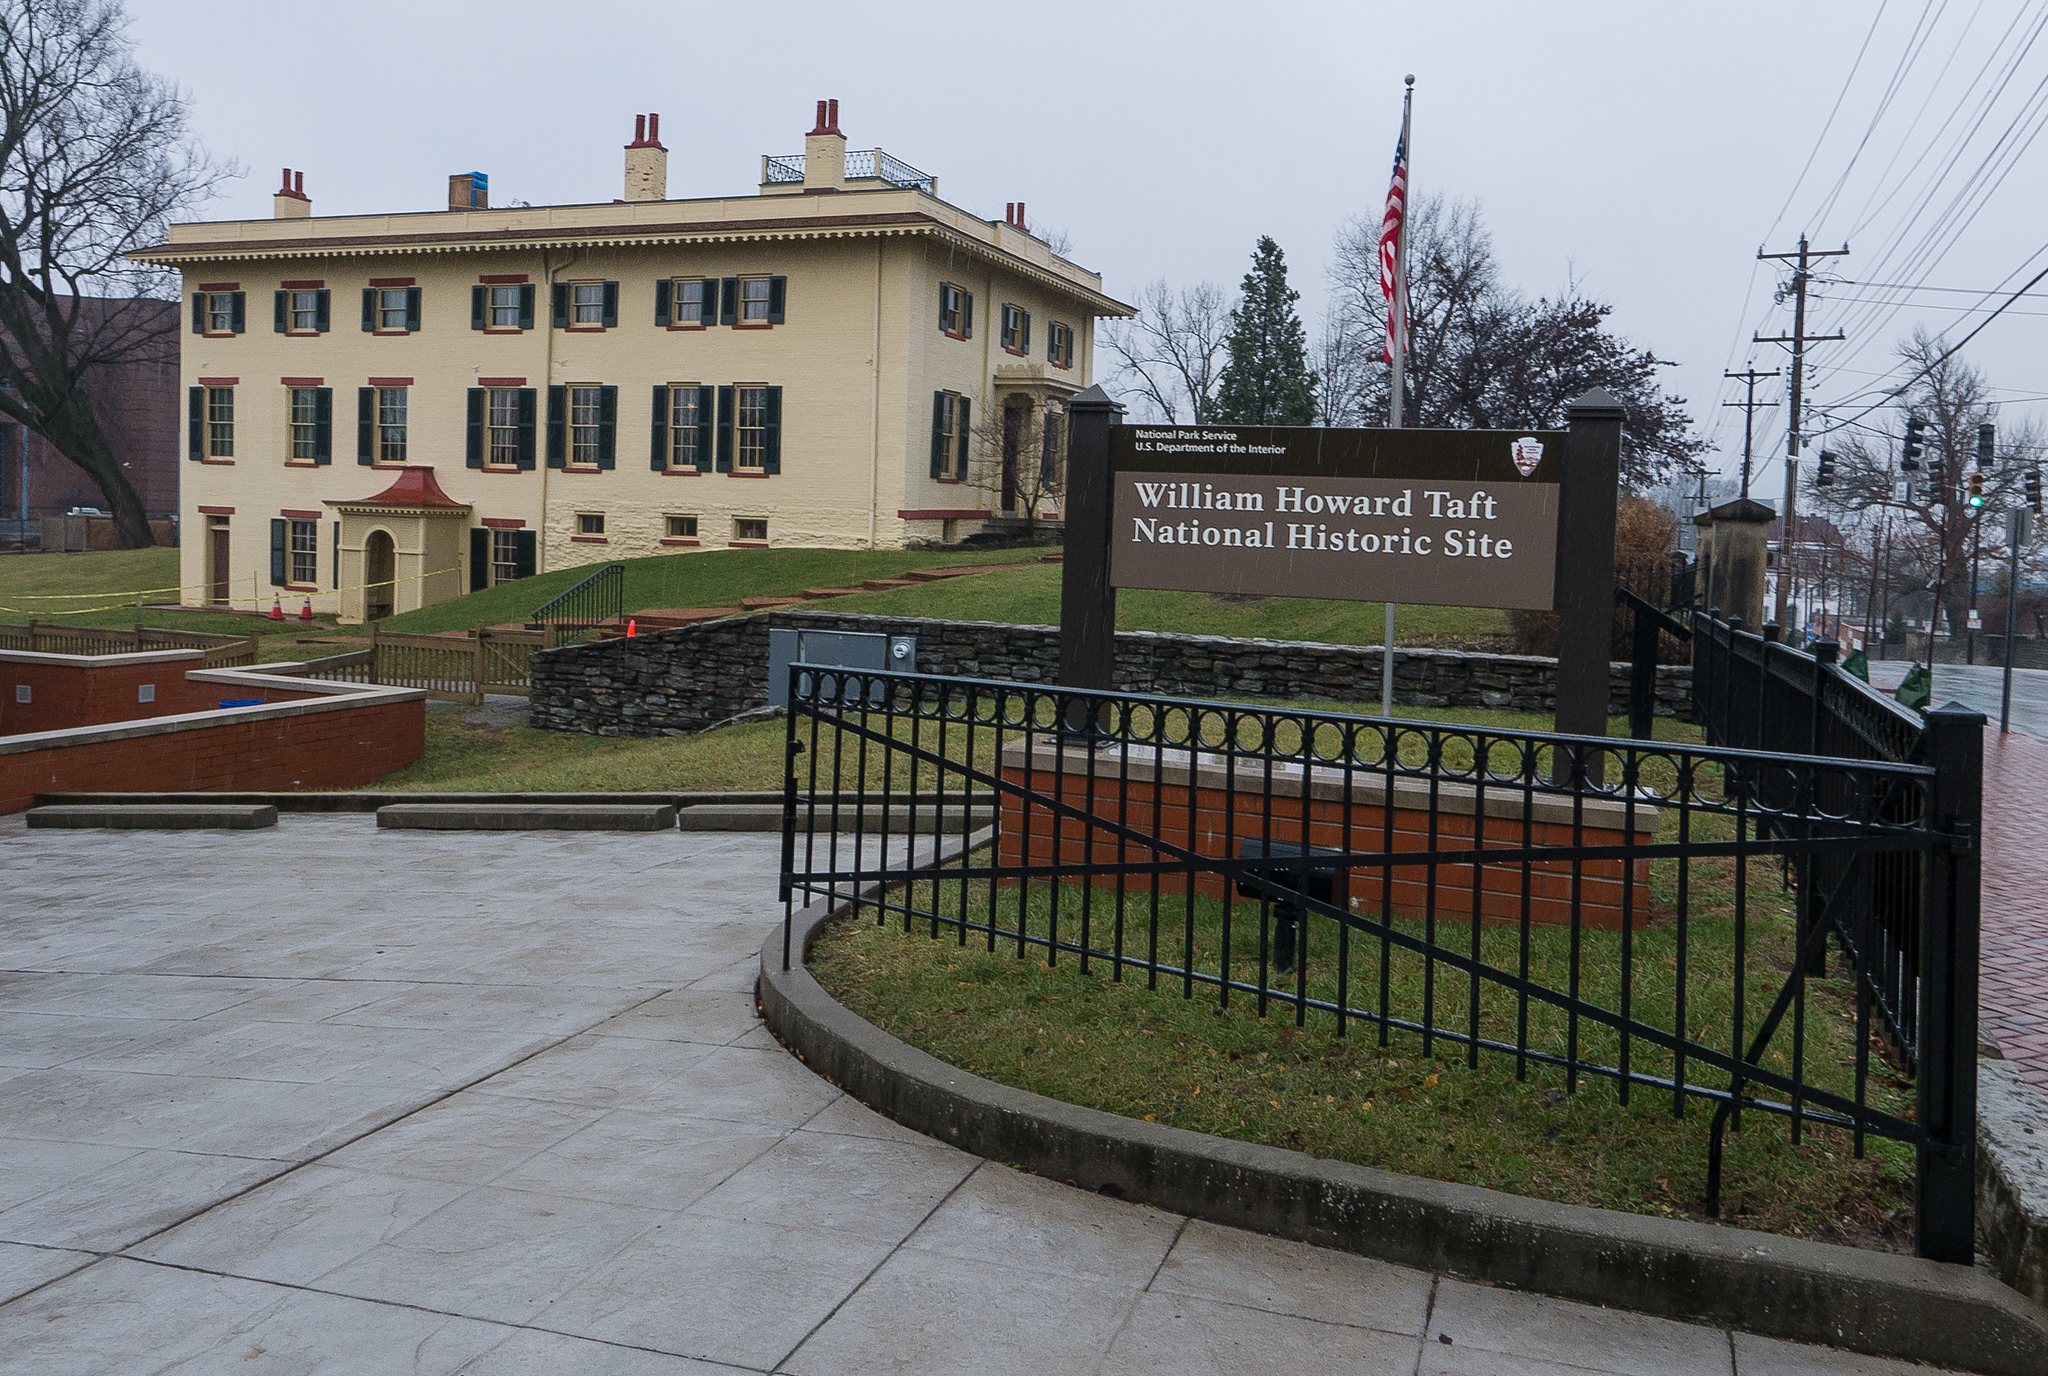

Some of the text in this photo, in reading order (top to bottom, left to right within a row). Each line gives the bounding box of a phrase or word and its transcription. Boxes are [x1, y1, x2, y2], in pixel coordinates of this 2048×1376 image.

[1135, 429, 1238, 441] National Park Service
[1135, 442, 1286, 455] U.S. Department of the Interior
[1133, 482, 1498, 520] William Howard Taft
[1131, 517, 1513, 559] National Historic Site
